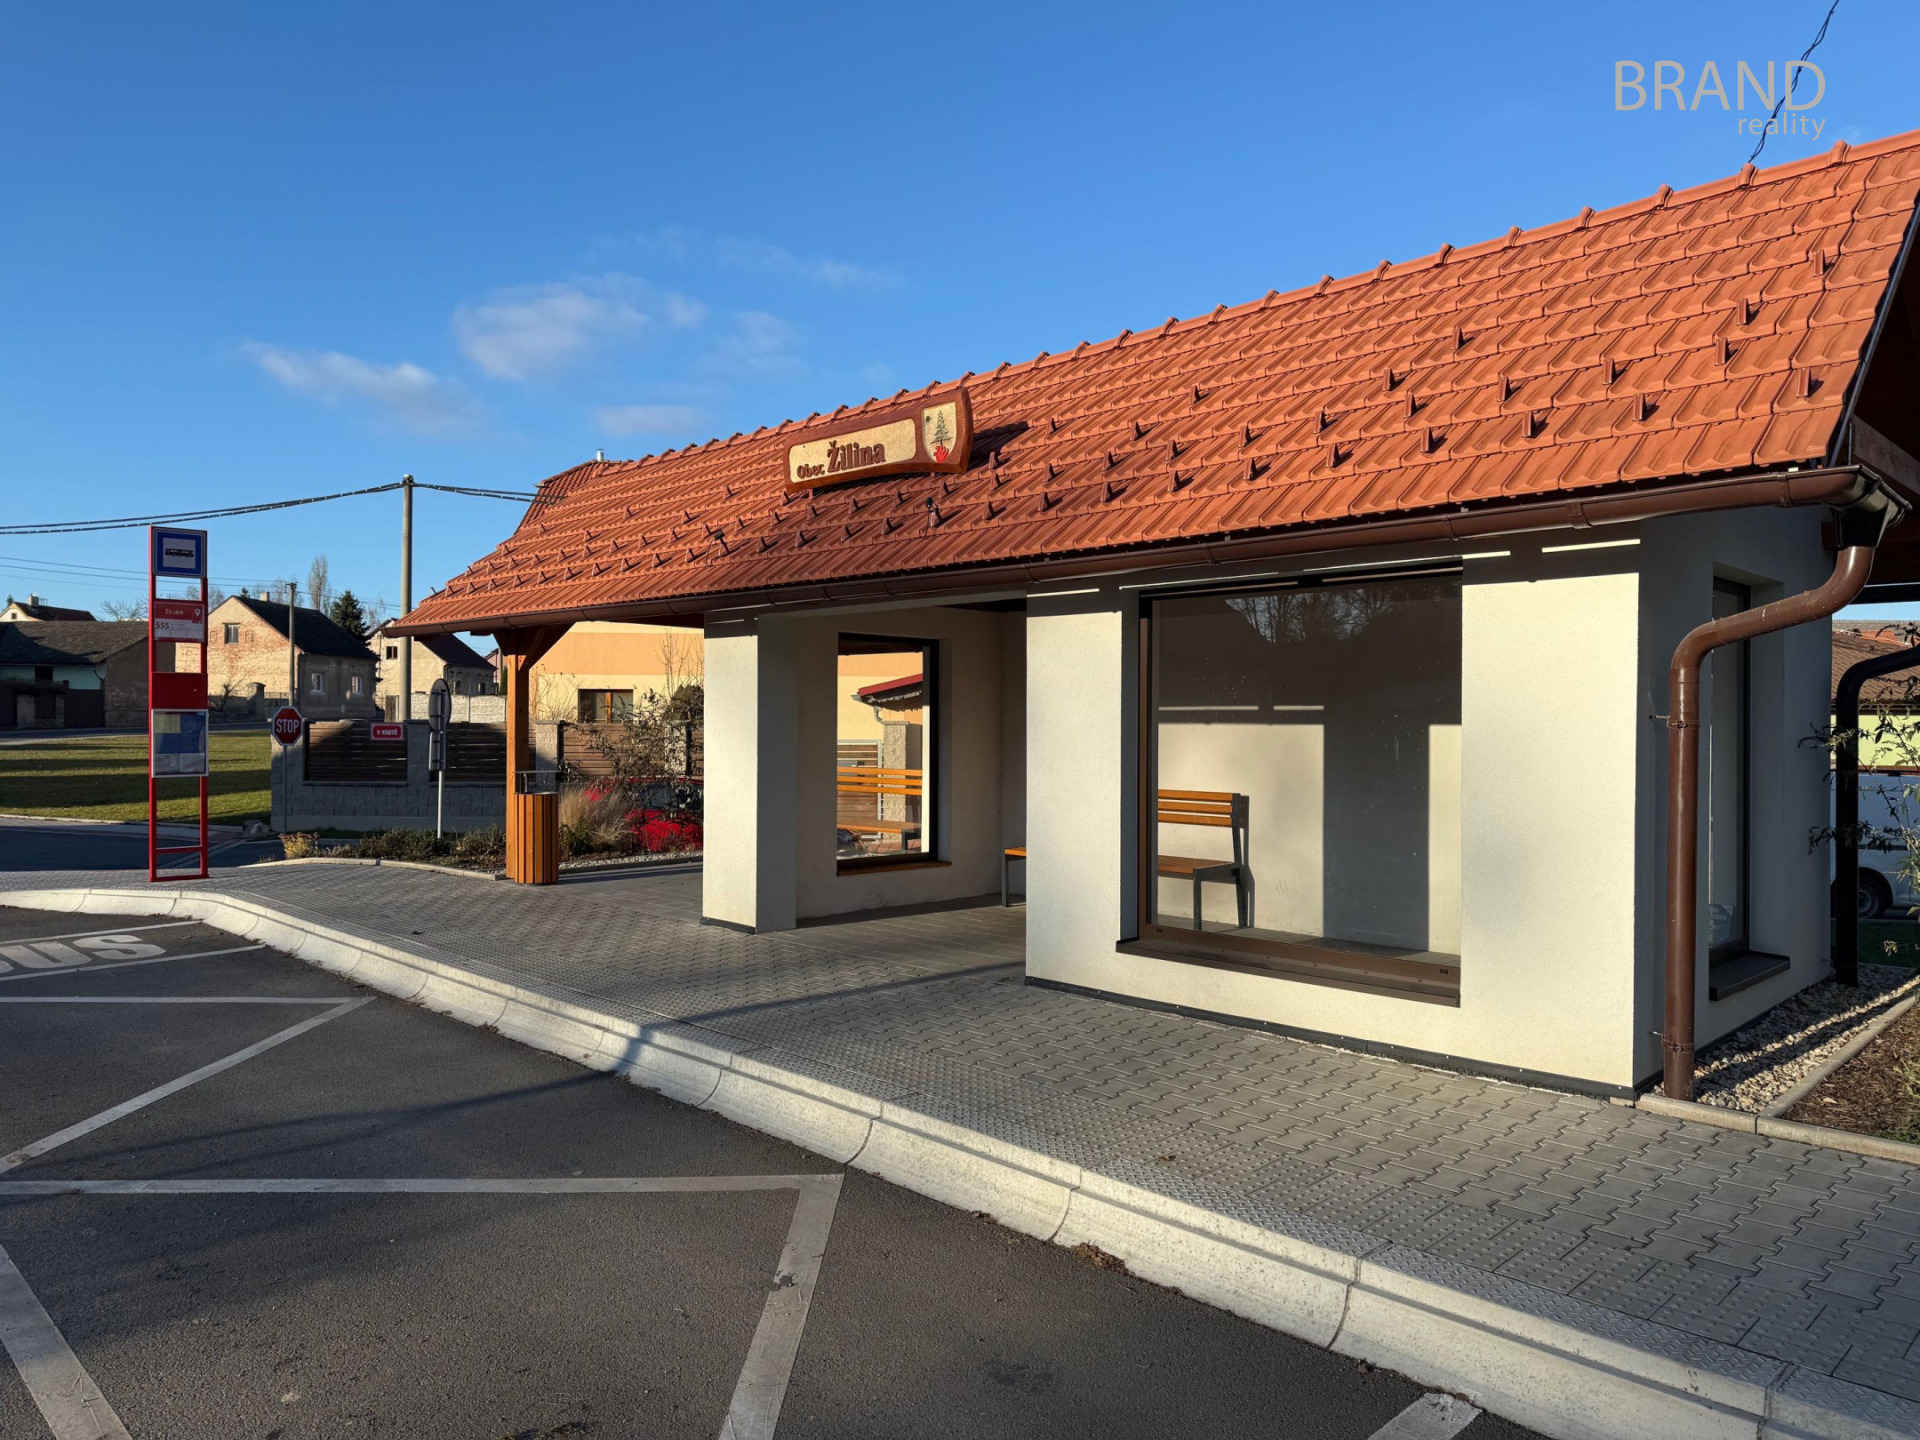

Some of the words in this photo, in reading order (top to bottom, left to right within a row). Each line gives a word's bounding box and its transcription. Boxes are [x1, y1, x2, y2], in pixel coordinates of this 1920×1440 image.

[796, 464, 826, 479] Obec
[827, 440, 887, 474] Žilina
[155, 621, 170, 629] 555
[276, 719, 300, 734] STOP
[0, 934, 167, 974] US
